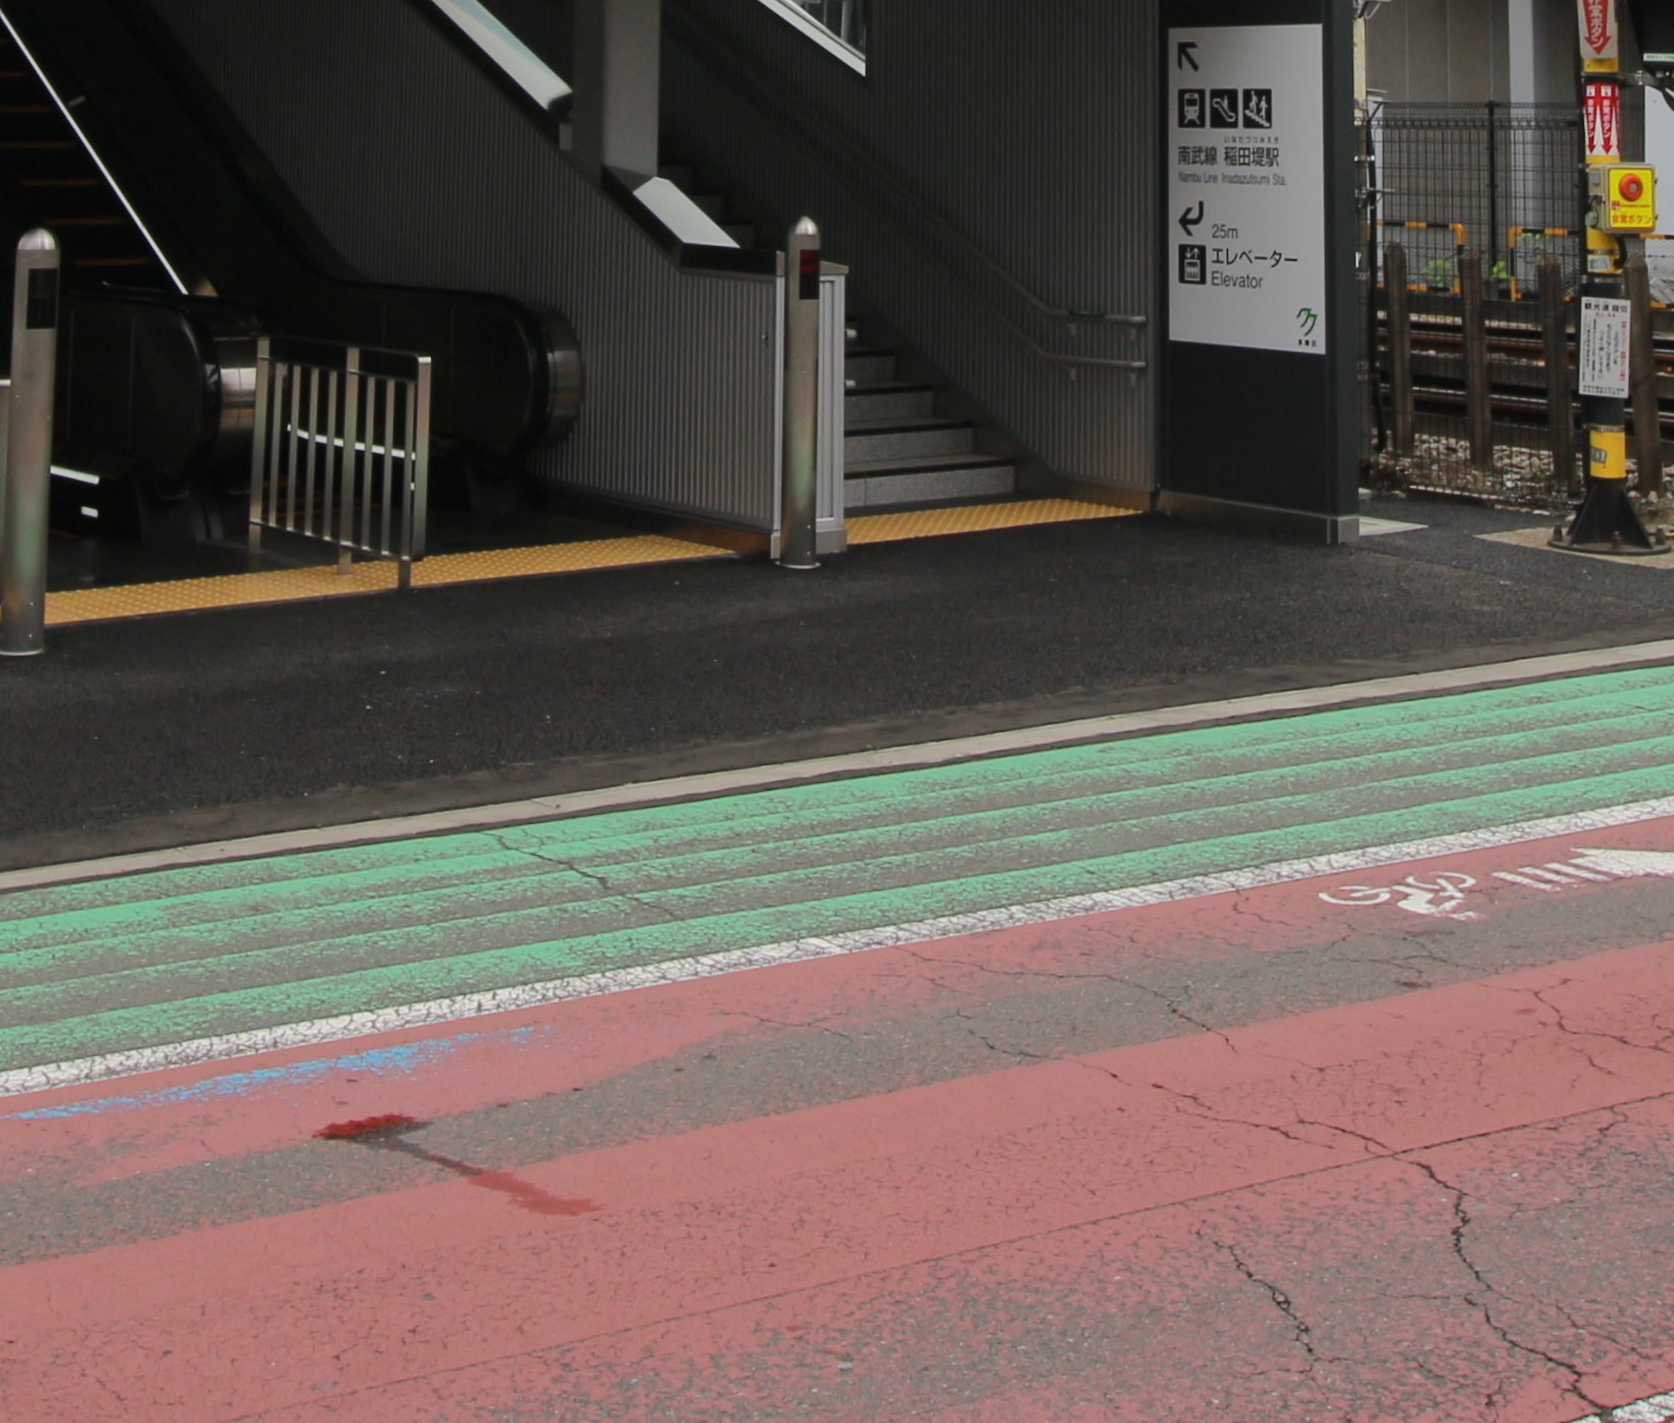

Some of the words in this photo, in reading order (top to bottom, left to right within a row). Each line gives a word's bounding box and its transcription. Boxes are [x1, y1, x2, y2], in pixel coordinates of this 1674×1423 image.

[1178, 146, 1218, 166] 南武線
[1224, 146, 1280, 167] 稲田堤駅
[1203, 172, 1218, 184] Line
[1221, 172, 1270, 186] Inadazutsumi
[1211, 223, 1239, 239] 25m
[1211, 247, 1298, 268] エレベーター
[1211, 270, 1263, 289] Elevator
